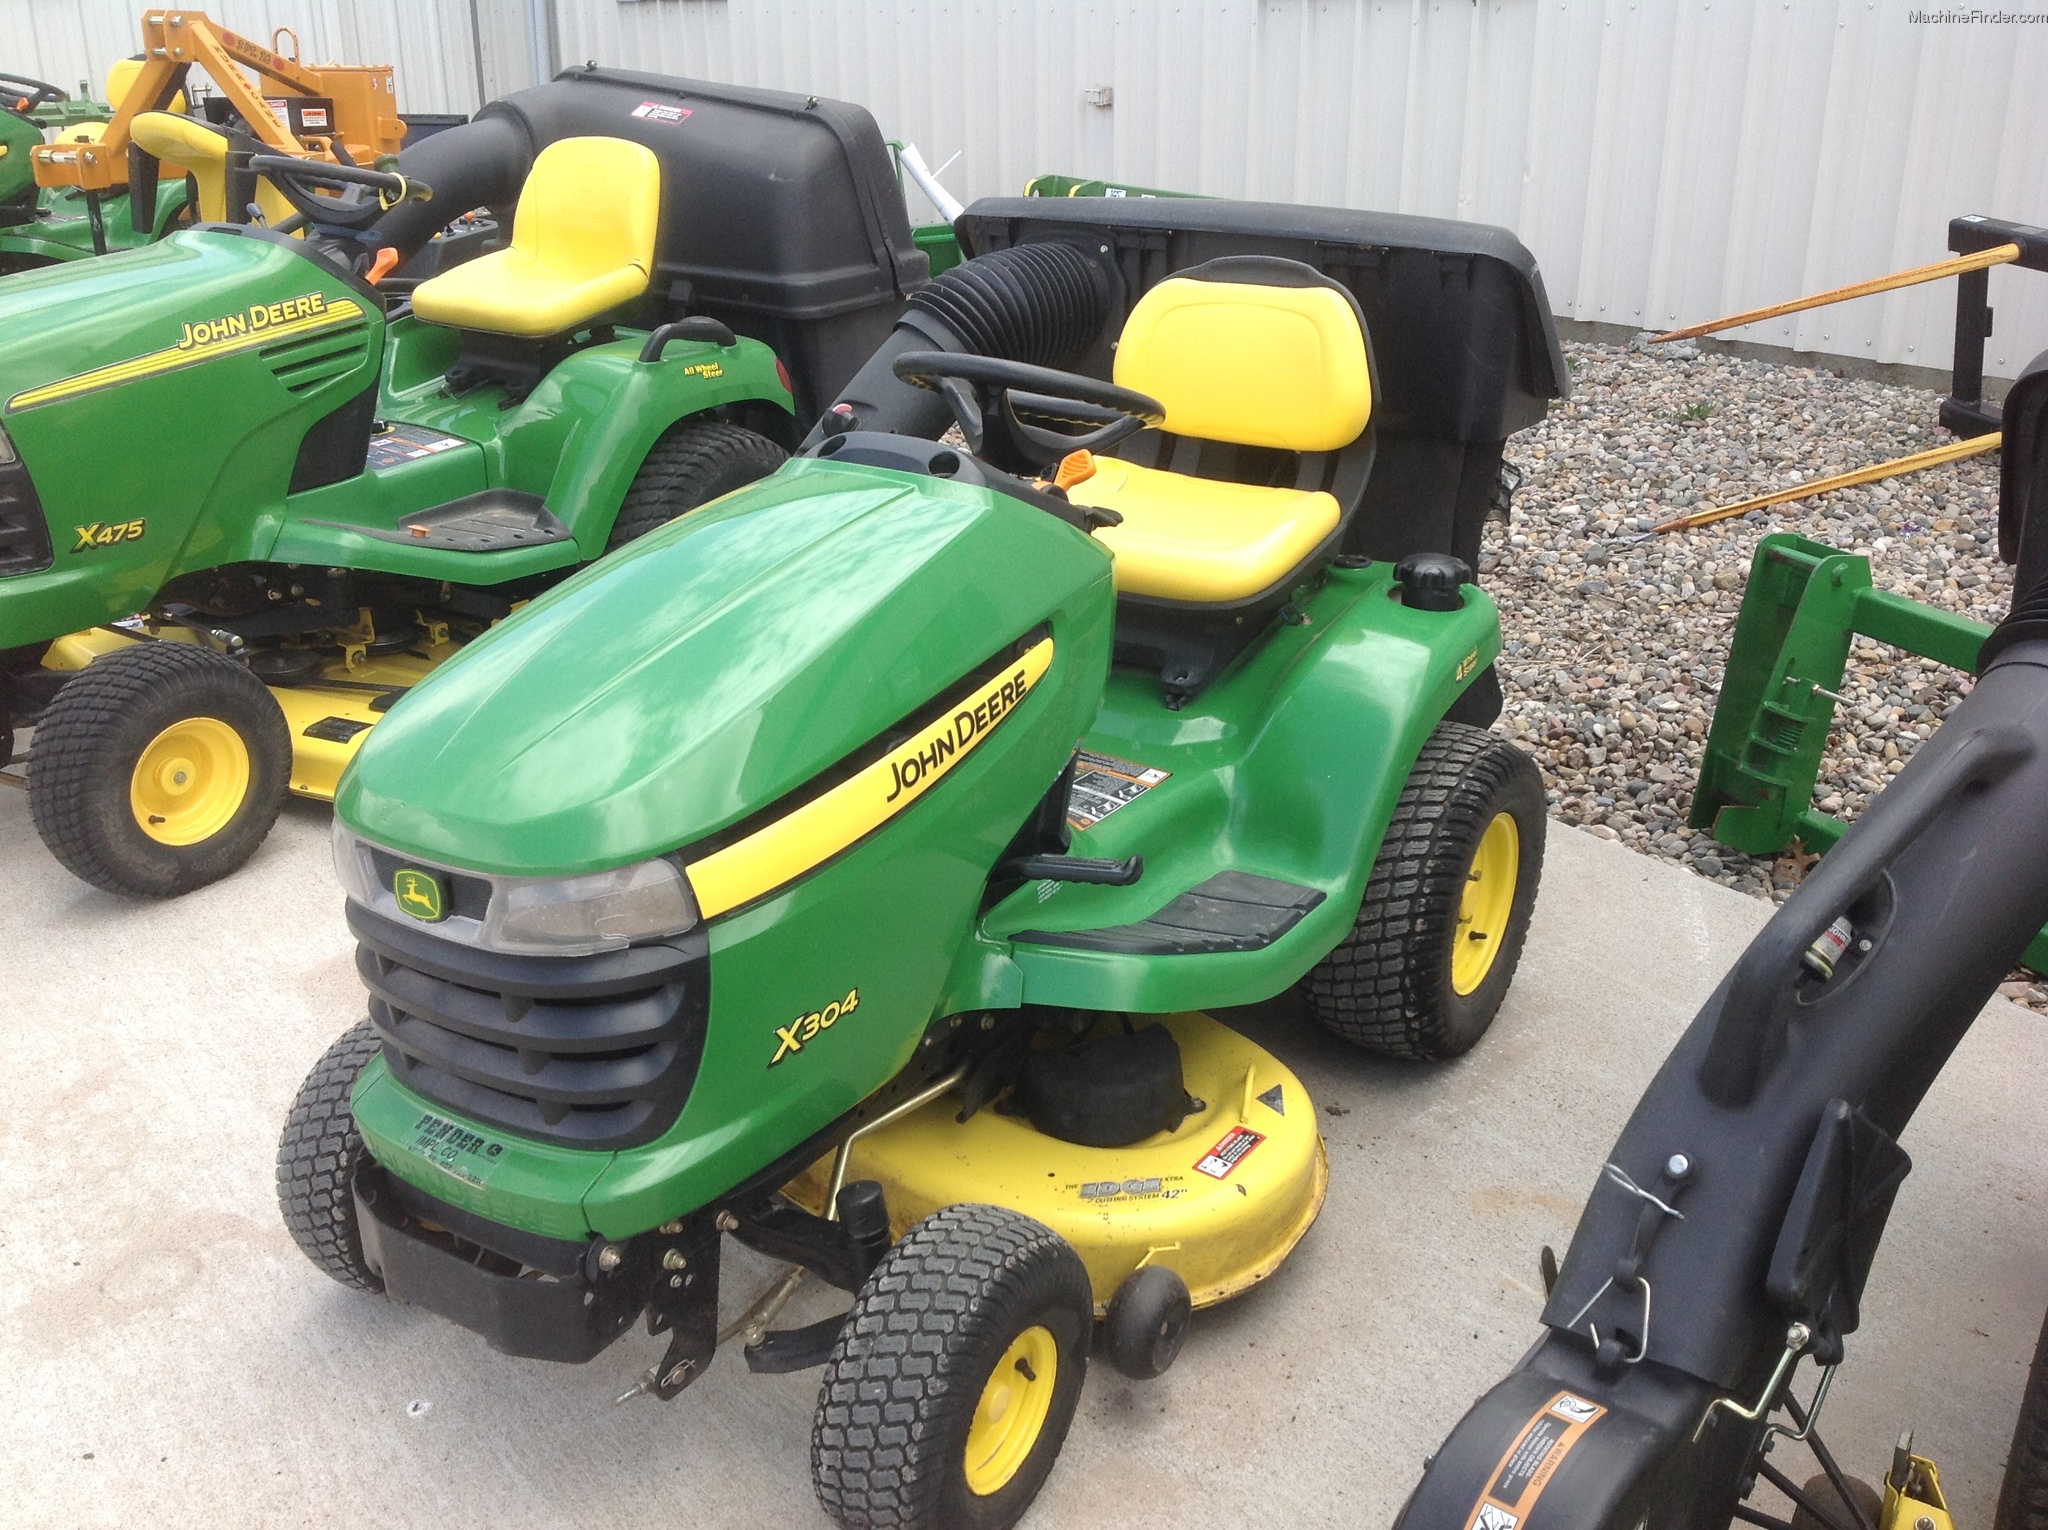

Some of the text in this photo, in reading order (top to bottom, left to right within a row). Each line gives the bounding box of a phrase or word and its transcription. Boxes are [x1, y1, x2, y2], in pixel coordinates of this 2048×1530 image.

[178, 292, 326, 350] JOHN DEERE
[71, 518, 146, 553] X475
[886, 669, 1028, 803] JOHN DEERE
[767, 986, 861, 1069] X304
[414, 1114, 485, 1155] PENDER
[414, 1135, 441, 1152] IMPL.
[1079, 1178, 1162, 1199] EDGE
[1532, 1445, 1562, 1487] WARNING
